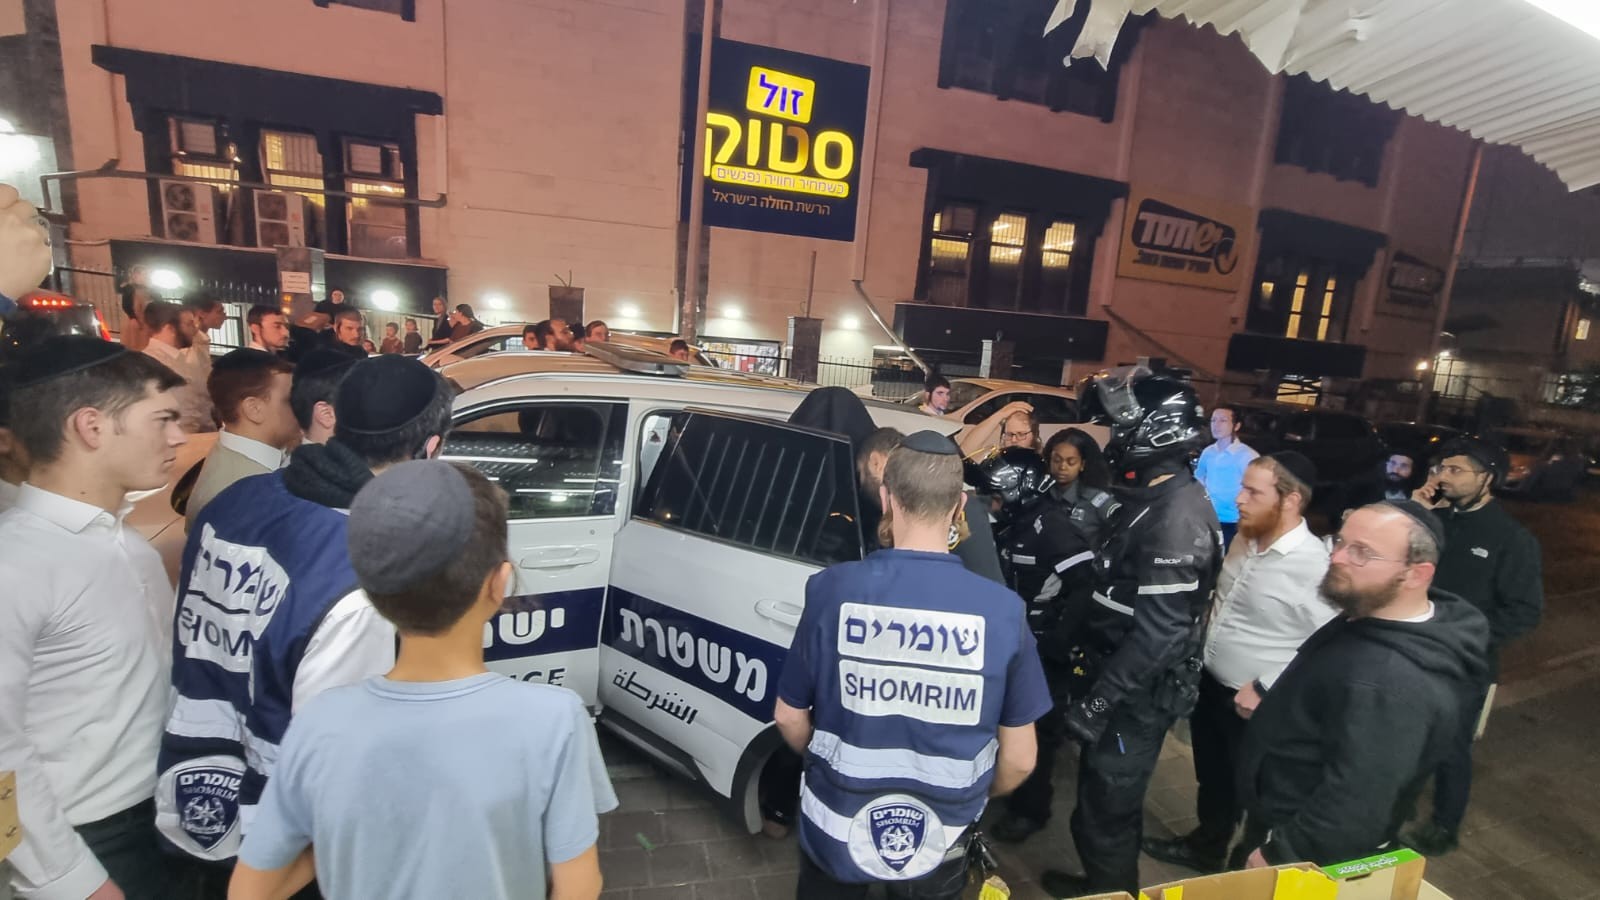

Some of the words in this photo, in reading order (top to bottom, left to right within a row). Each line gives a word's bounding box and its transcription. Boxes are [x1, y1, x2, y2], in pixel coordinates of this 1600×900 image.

[759, 73, 804, 115] זול
[704, 112, 854, 180] סטוק
[712, 188, 758, 206] בישראל
[799, 177, 845, 194] כשמחיר
[760, 194, 794, 211] הזולה
[795, 201, 831, 216] הרשת
[844, 615, 980, 657] שומרים
[618, 606, 768, 703] משטרת
[612, 667, 699, 725] الشرطة
[844, 672, 977, 712] SHOMRIM
[180, 772, 241, 791] שומרים
[872, 807, 924, 821] שומרים
